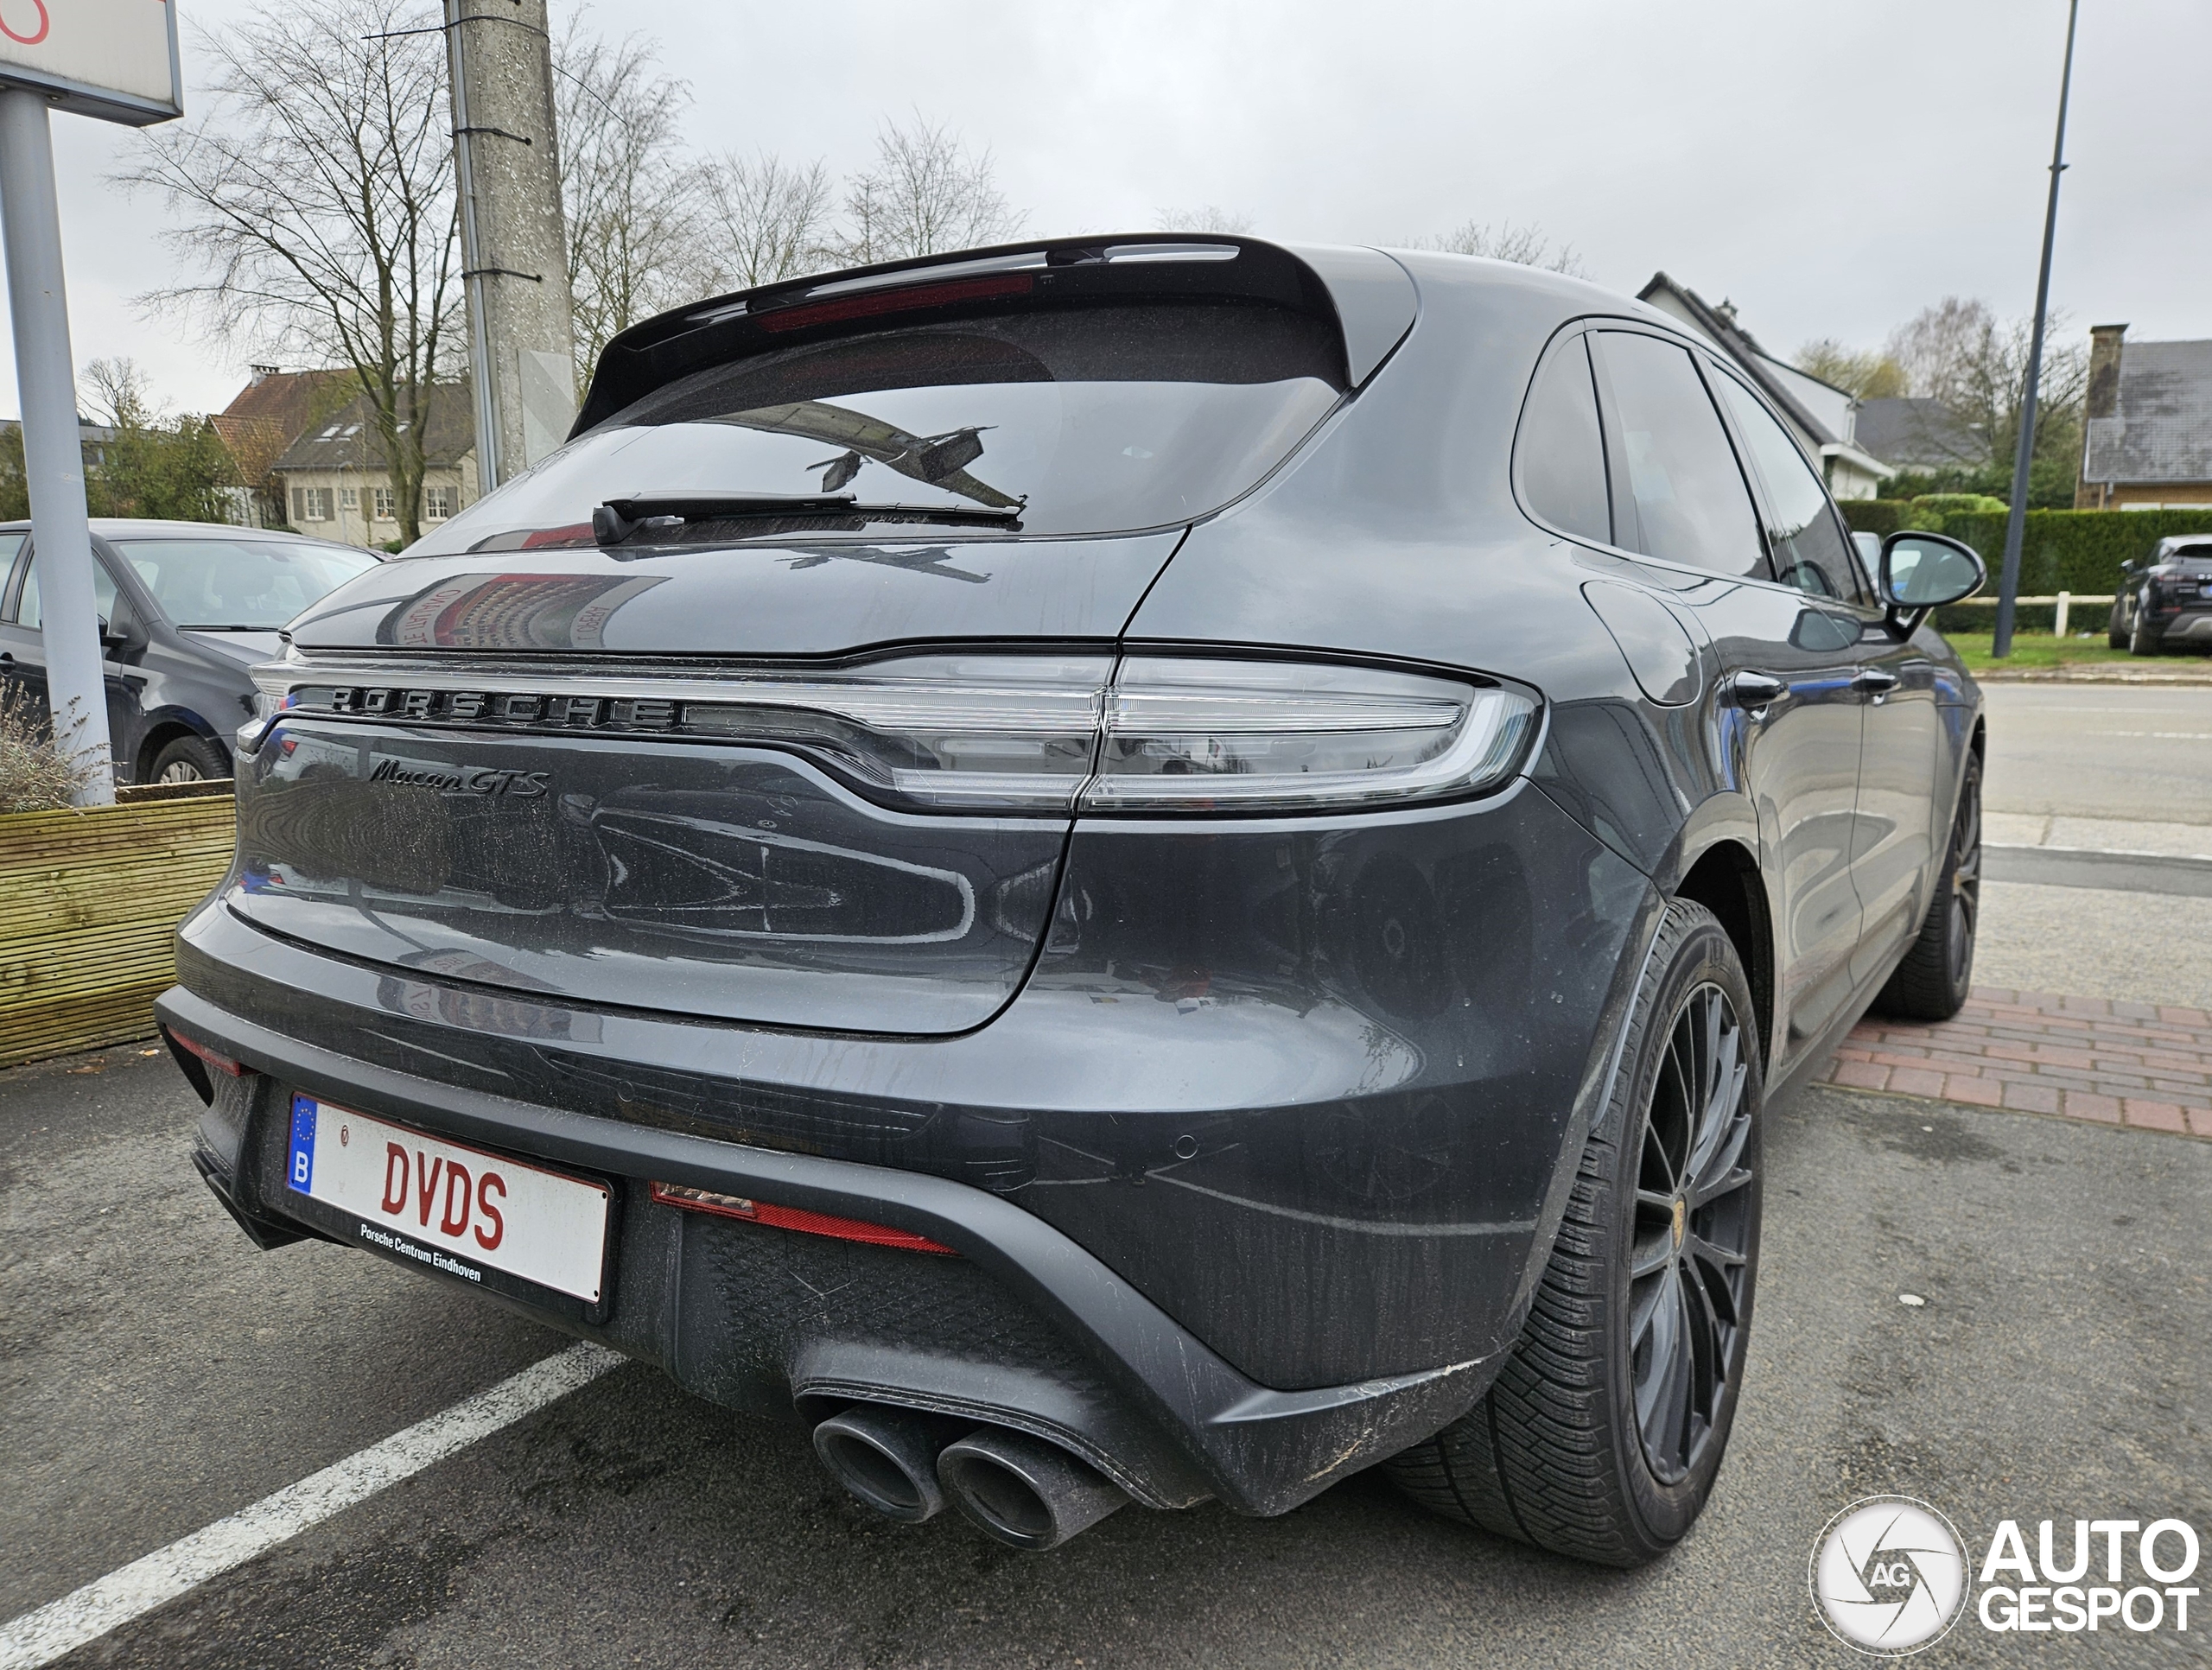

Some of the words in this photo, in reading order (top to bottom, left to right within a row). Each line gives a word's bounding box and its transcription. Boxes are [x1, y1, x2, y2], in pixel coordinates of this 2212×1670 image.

[332, 688, 674, 727] PORSCHE
[369, 759, 463, 791] Macan
[467, 769, 550, 797] GTS
[294, 1151, 308, 1184] B
[381, 1141, 507, 1251] DVDS
[360, 1223, 394, 1248] Porsche
[394, 1237, 432, 1264] Centrum
[432, 1252, 481, 1282] Eindhoven
